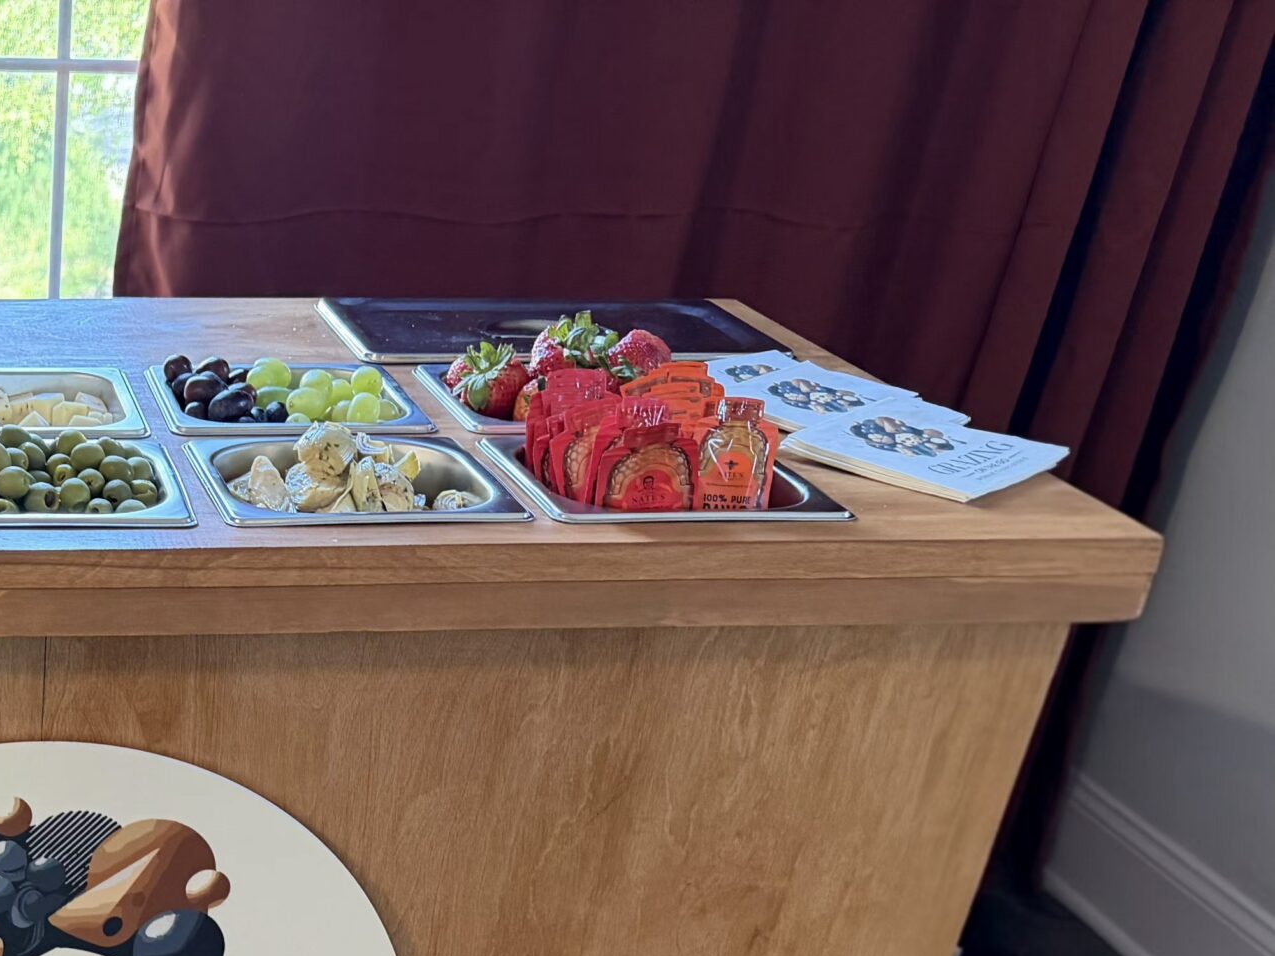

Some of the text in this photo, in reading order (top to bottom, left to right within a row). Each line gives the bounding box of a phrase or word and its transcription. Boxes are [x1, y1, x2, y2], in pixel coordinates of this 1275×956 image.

[927, 440, 1015, 475] GRAZING
[703, 493, 752, 505] 100% PURE
